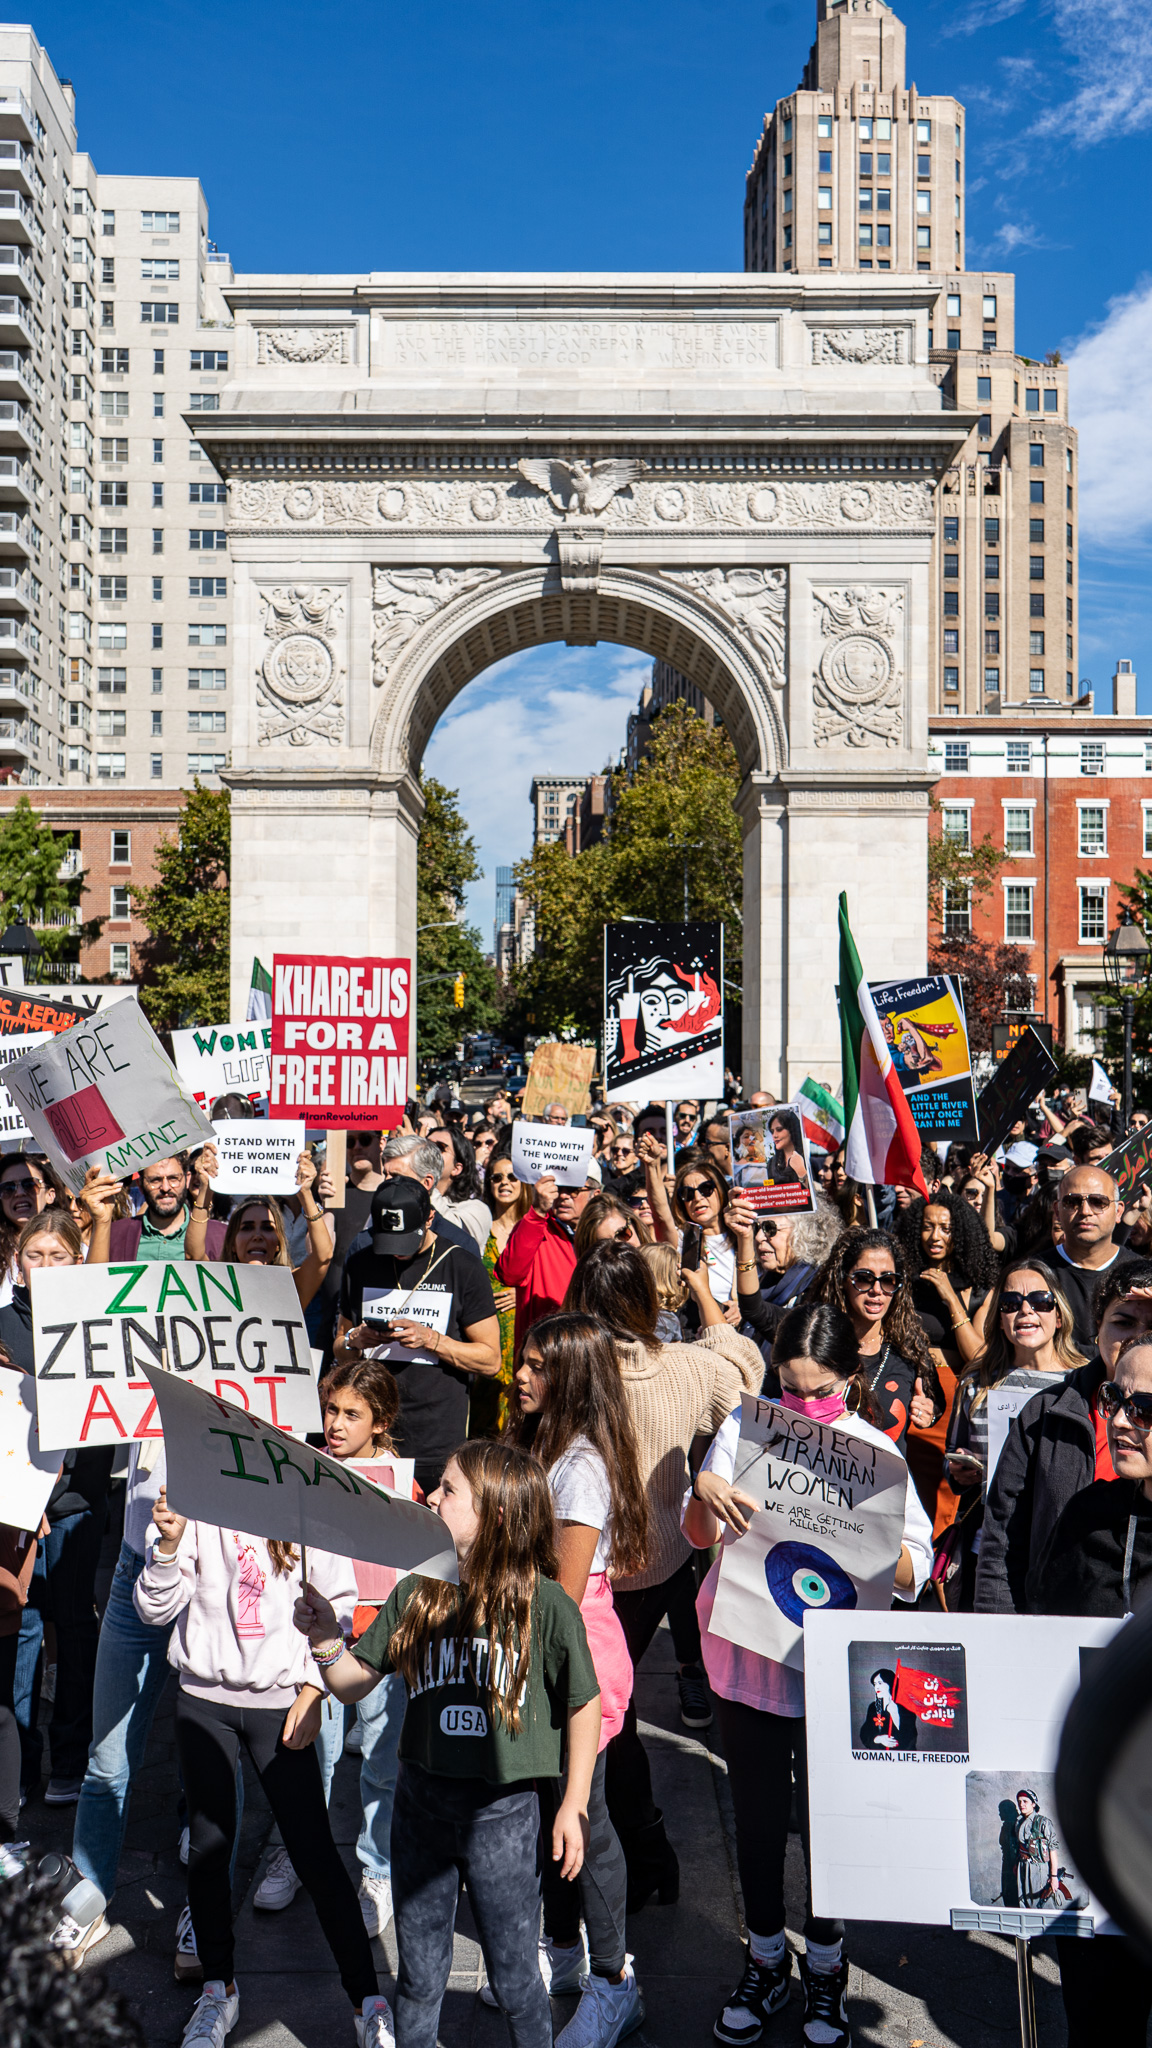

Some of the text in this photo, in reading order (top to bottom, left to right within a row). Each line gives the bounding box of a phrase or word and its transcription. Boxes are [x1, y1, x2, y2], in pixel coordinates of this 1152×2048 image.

[394, 324, 768, 336] LET US RAISE A STANDARD TO WHICH THE WISE
[396, 338, 768, 350] AND THE HONEST CAN REPAIR THE EVENT
[395, 351, 768, 364] IS IN THE HAND OF GOD WASHINGTON
[274, 965, 408, 1018] KHAREJIS
[192, 1029, 272, 1057] WOME
[284, 1021, 397, 1050] FOR A
[14, 1022, 131, 1111] WE ARE
[223, 1054, 271, 1085] LIF
[271, 1054, 336, 1105] FREE
[340, 1055, 407, 1106] IRAN
[910, 1093, 930, 1102] AND
[911, 1101, 969, 1111] LITTLE RIVER
[50, 1096, 107, 1151] ALL
[299, 1112, 378, 1121] #IranRevolution
[937, 1110, 963, 1119] ONCE
[947, 1119, 961, 1127] ME
[105, 1120, 188, 1174] AMINI
[224, 1138, 263, 1146] STAND
[525, 1138, 557, 1148] STAND
[559, 1142, 585, 1151] WITH
[247, 1152, 291, 1160] WOMEN
[522, 1149, 579, 1162] THE WOMEN
[251, 1166, 279, 1174] IRAN
[105, 1264, 244, 1314] ZAN
[370, 1306, 374, 1315] I
[412, 1307, 440, 1318] WITH
[38, 1315, 311, 1380] ZENDEGI
[79, 1377, 292, 1441] AZDI
[755, 1400, 884, 1468] PROTECT
[209, 1427, 392, 1504] IRAN
[776, 1434, 875, 1488] IRANIAN
[768, 1463, 853, 1511] WOMEN
[764, 1499, 865, 1534] WE ARE GETTING
[923, 1677, 939, 1691] ژن
[446, 1710, 486, 1733] USA
[852, 1751, 970, 1763] WOMAN, LIFE, FREEDOM
